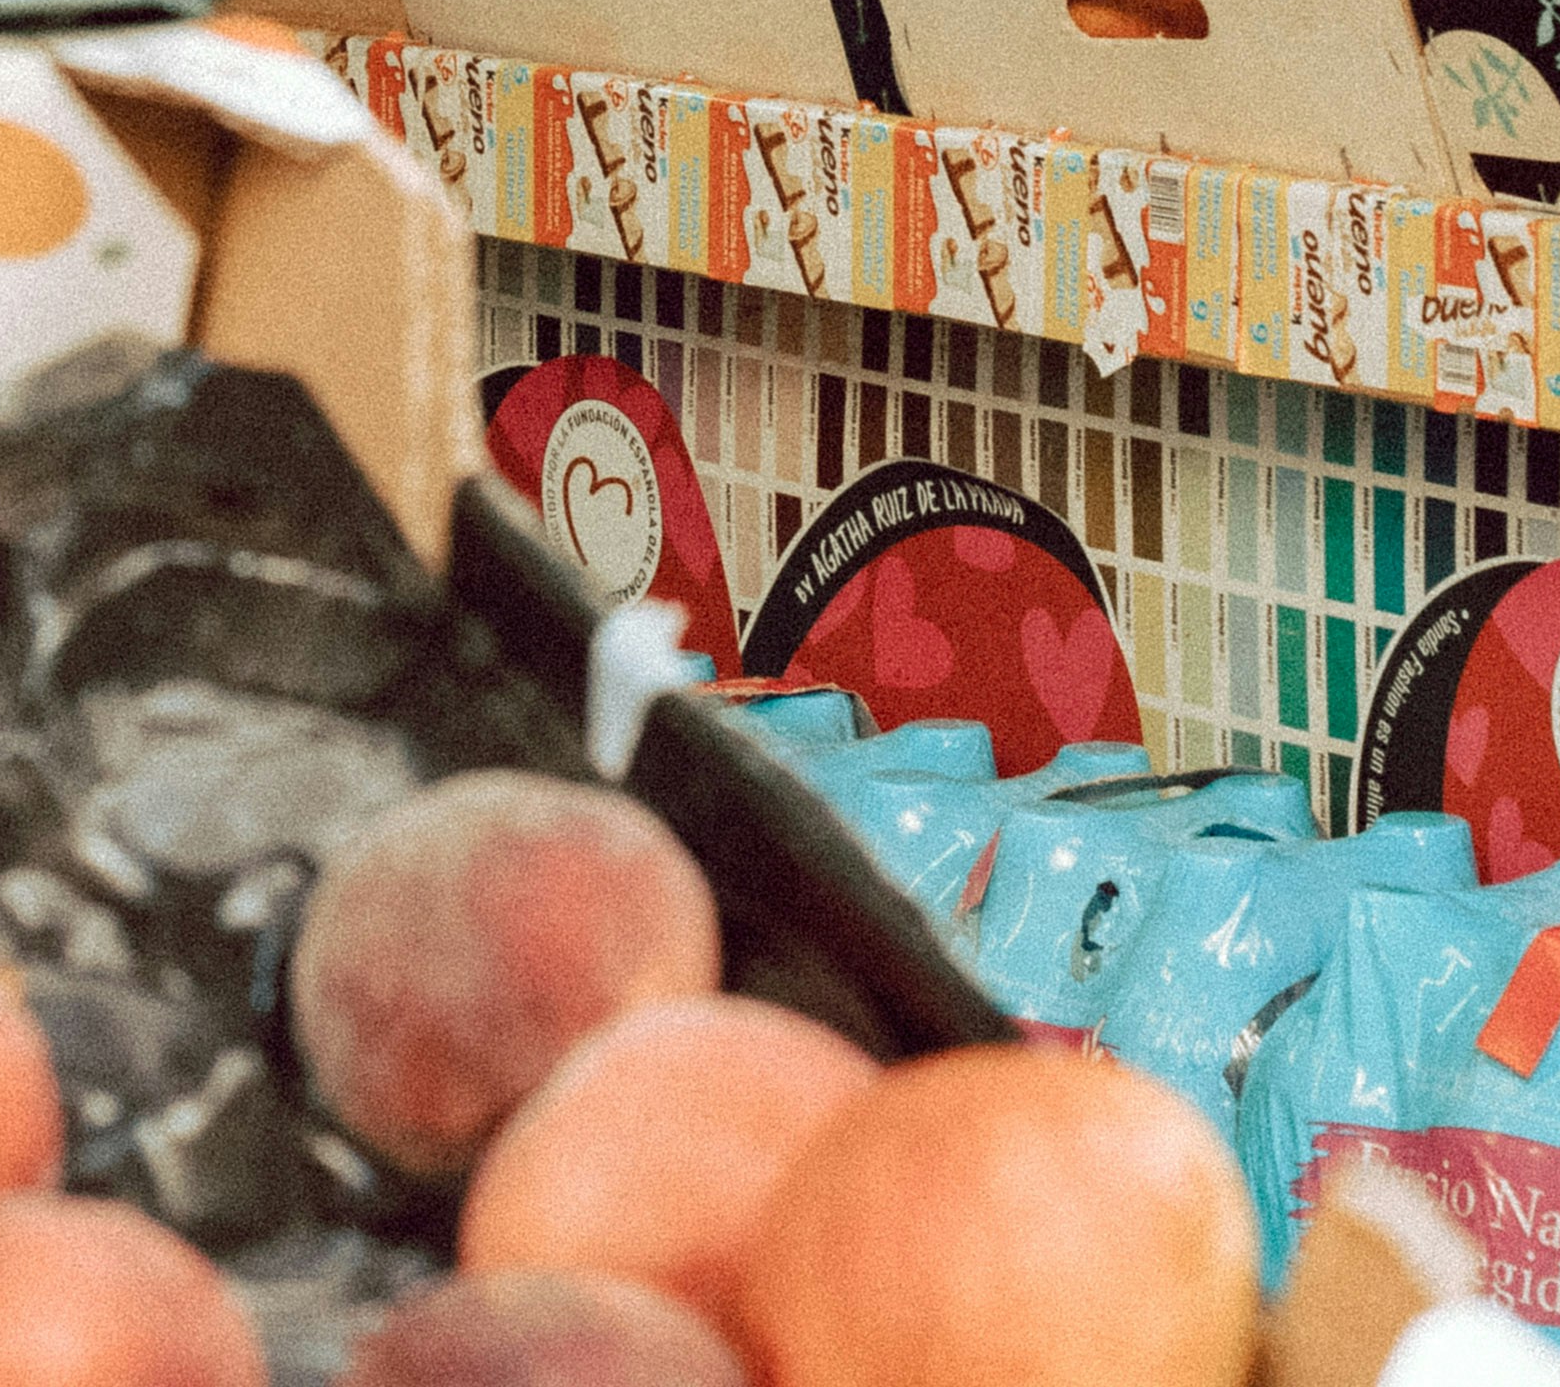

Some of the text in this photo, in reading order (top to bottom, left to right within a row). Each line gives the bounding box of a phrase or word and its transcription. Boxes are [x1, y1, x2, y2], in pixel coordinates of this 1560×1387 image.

[485, 69, 496, 124] Kinder
[657, 96, 669, 154] Kinder
[839, 127, 851, 186] Kinder
[1032, 155, 1045, 216] Kinder
[1291, 265, 1304, 327] Kinder
[1303, 228, 1332, 366] bueno
[567, 407, 630, 441] FUNDACIÓN
[628, 435, 659, 529] ESPAÑOLA
[643, 534, 658, 566] DEL
[794, 573, 816, 605] BY
[811, 509, 875, 586] AGATHA
[870, 486, 914, 532] RUIZ
[916, 480, 941, 516] DE
[940, 480, 968, 511] LA
[1370, 650, 1426, 774] Fashion es un
